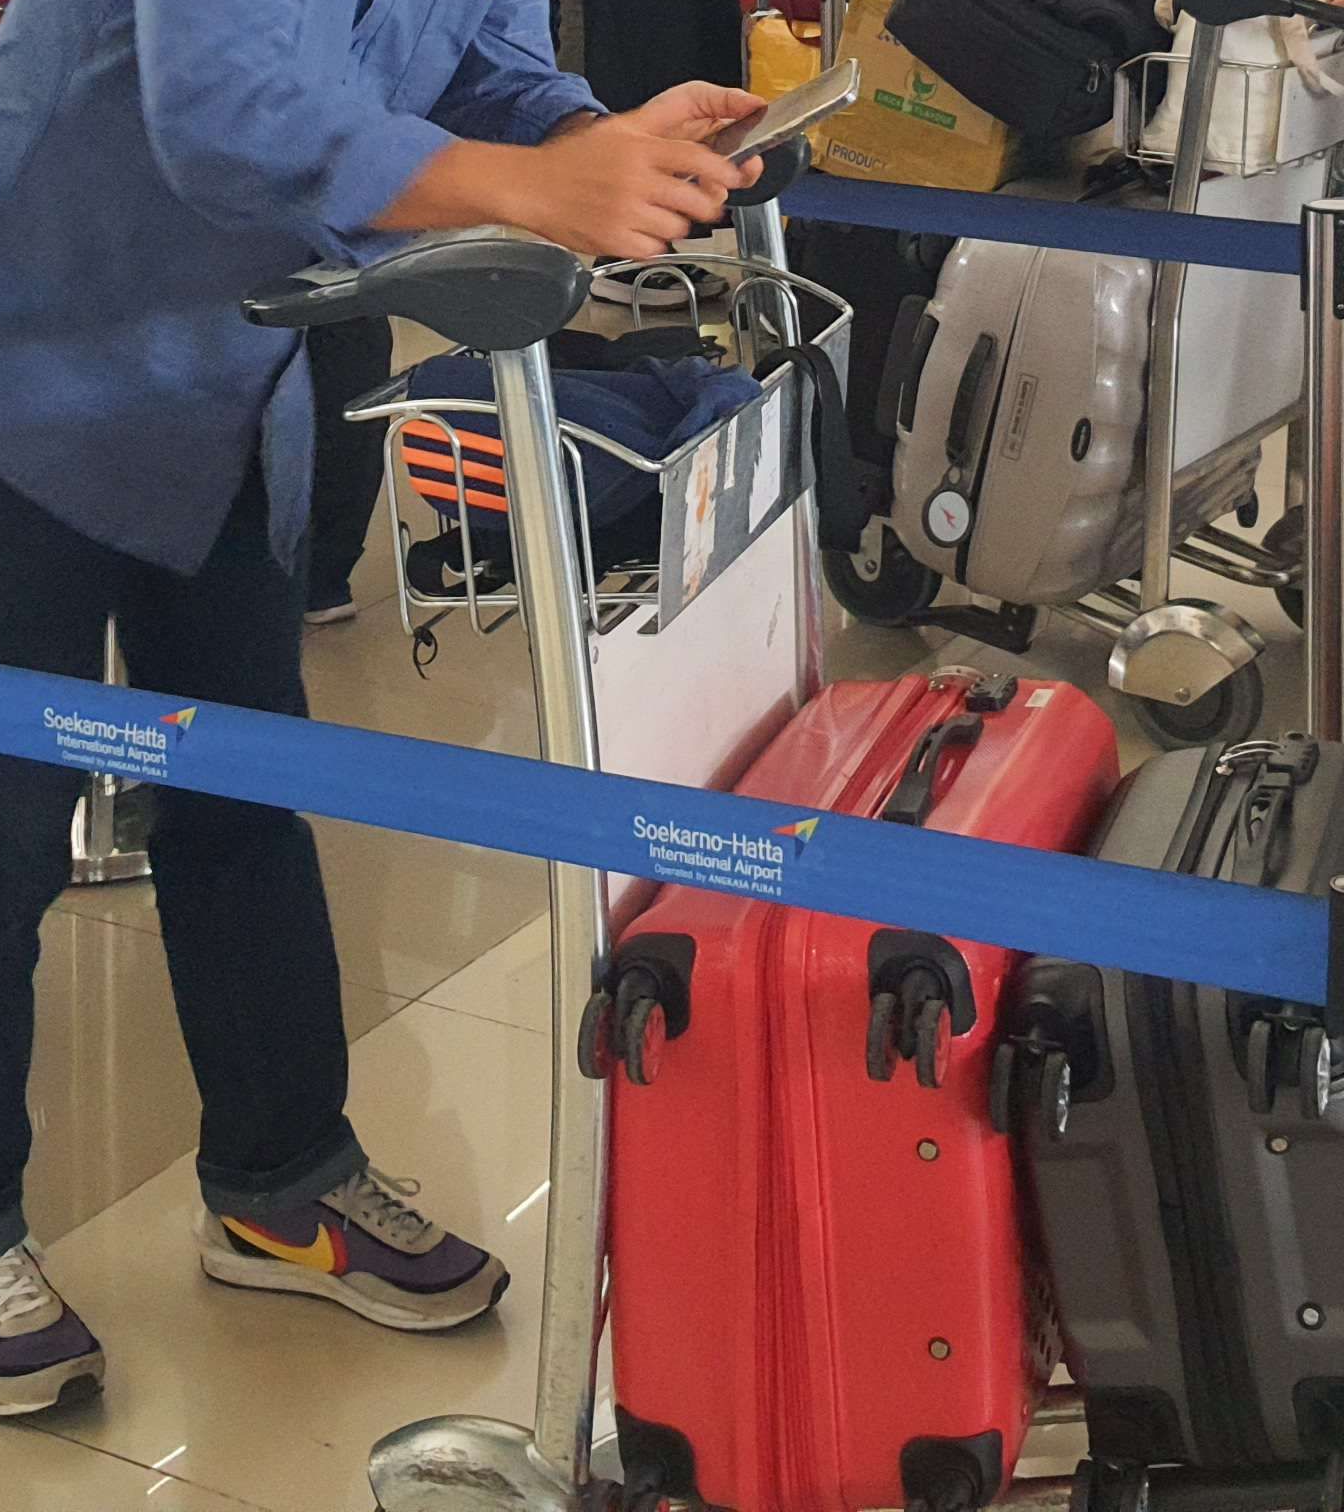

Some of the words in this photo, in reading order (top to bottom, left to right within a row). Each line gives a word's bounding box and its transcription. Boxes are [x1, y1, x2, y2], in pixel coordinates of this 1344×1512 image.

[43, 706, 167, 750] Soekarno-Hatta
[56, 732, 125, 757] International
[127, 746, 168, 765] Airport
[633, 815, 784, 864] Soekarno-Hatta
[649, 843, 731, 872] International
[733, 858, 783, 882] Airport
[654, 863, 694, 881] Operated
[695, 871, 706, 884] by
